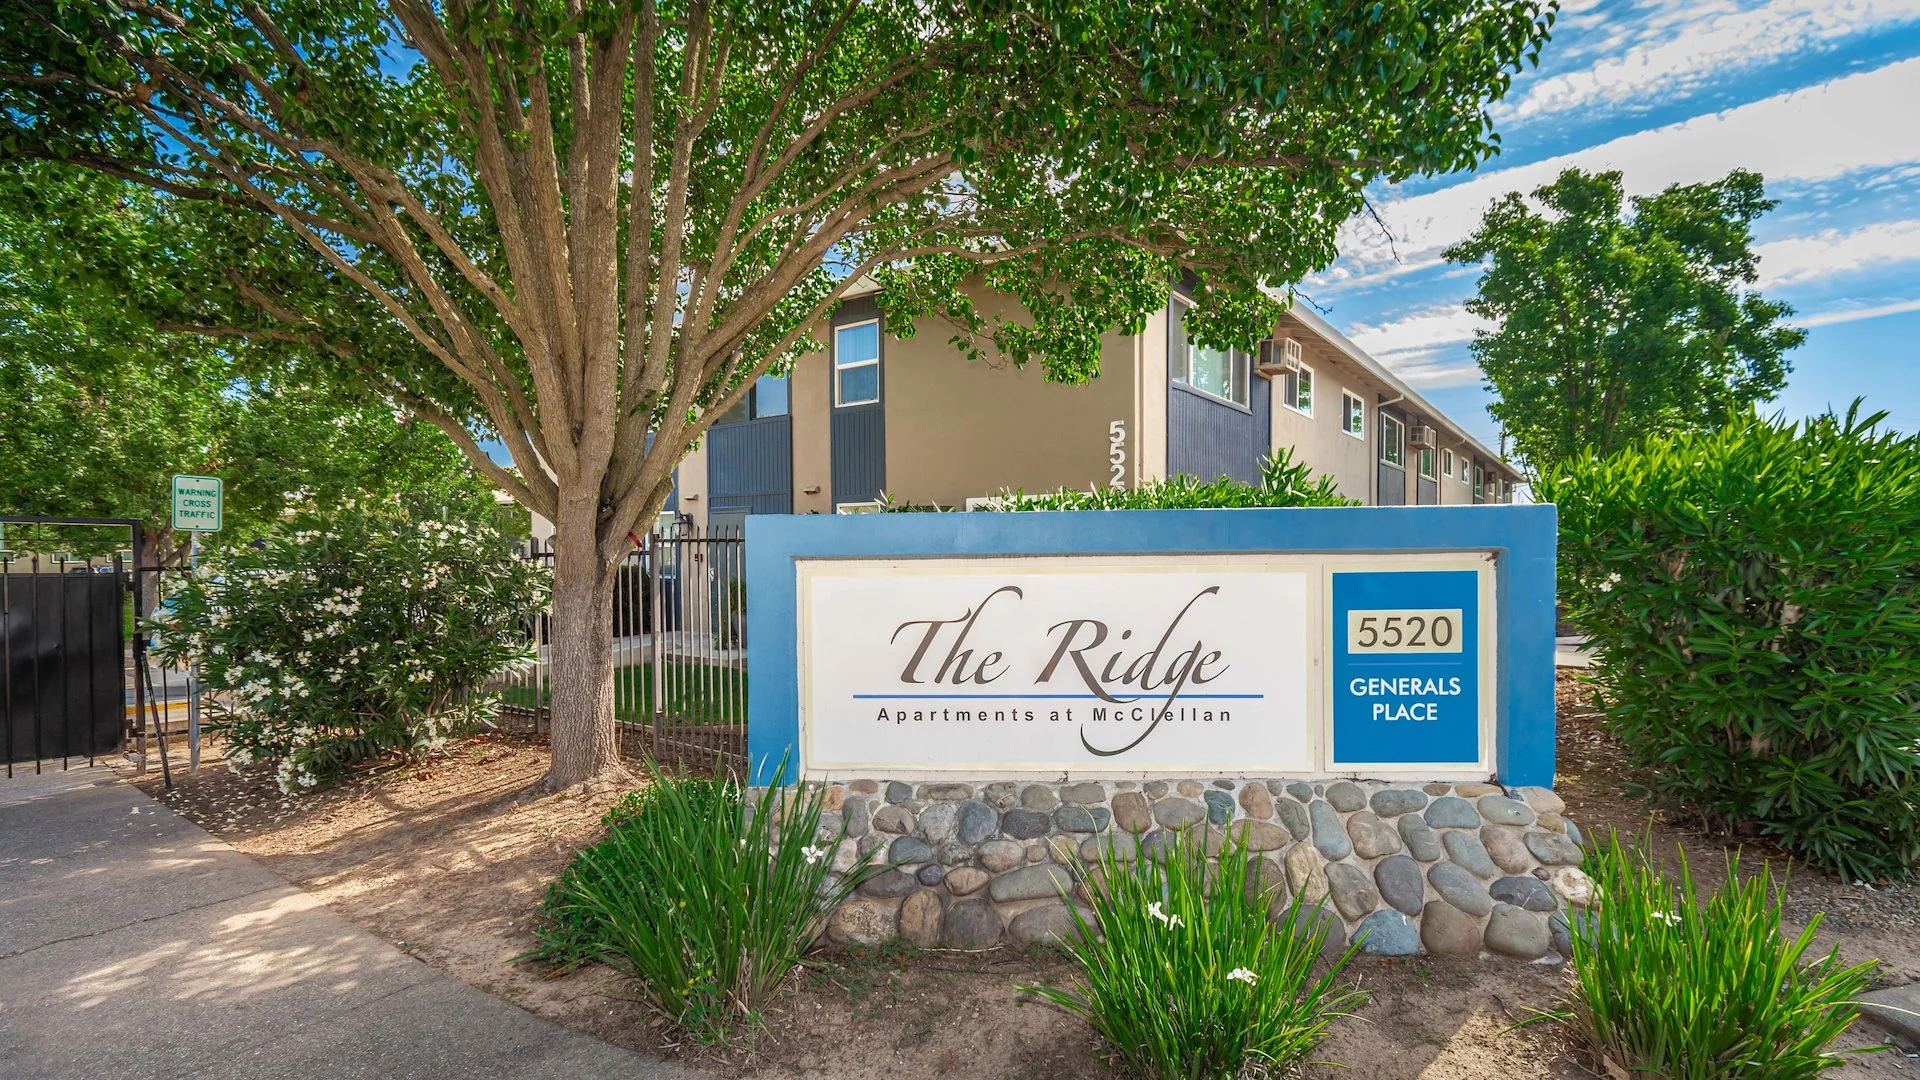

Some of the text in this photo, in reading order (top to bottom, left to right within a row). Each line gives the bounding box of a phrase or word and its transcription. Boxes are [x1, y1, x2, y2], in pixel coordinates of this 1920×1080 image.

[178, 489, 216, 497] WARNING
[183, 499, 212, 508] CROSS
[179, 510, 215, 519] TRAFFIC
[1357, 615, 1453, 648] 5520
[890, 585, 1230, 756] The Ridge
[1349, 677, 1462, 697] GENERALS
[876, 707, 1232, 725] Apartments at McClellan
[1372, 702, 1438, 721] PLACE
